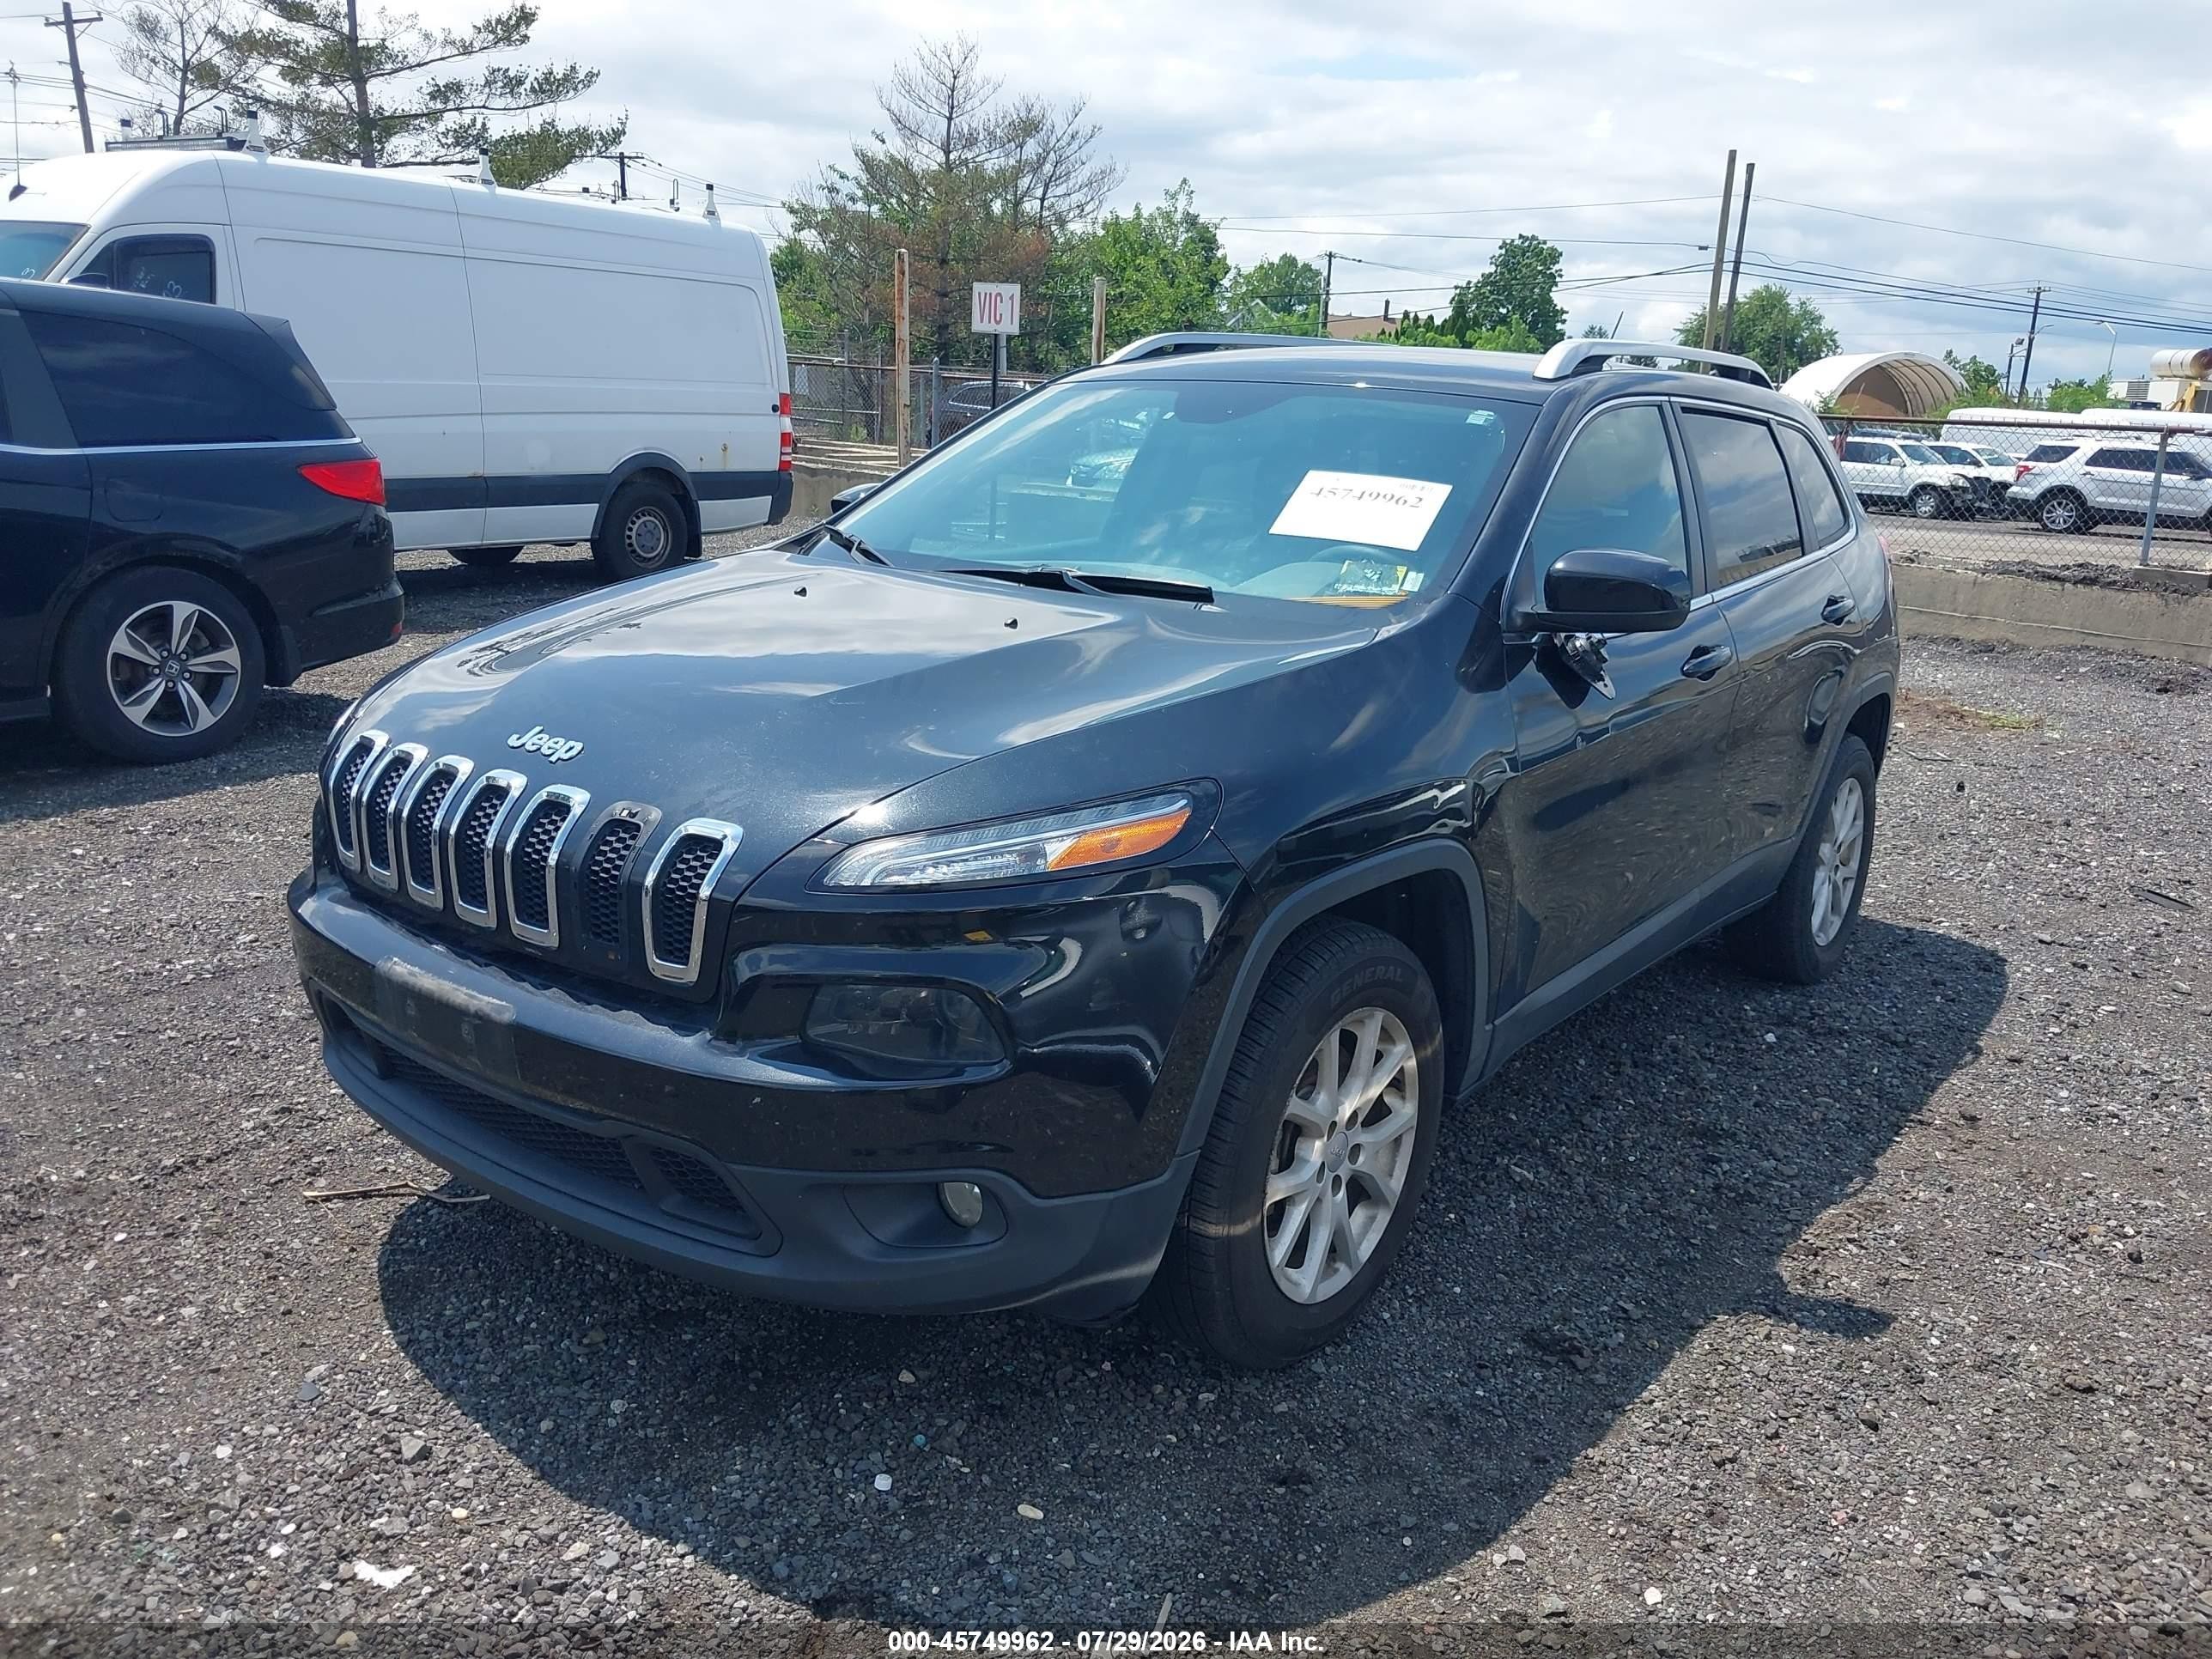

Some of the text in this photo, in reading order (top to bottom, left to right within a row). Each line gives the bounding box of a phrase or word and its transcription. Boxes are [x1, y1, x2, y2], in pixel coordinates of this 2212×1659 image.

[978, 291, 1015, 325] VIC 1
[1310, 486, 1425, 508] 45749962
[507, 726, 585, 763] Jeep
[1331, 964, 1403, 1005] GENERAL
